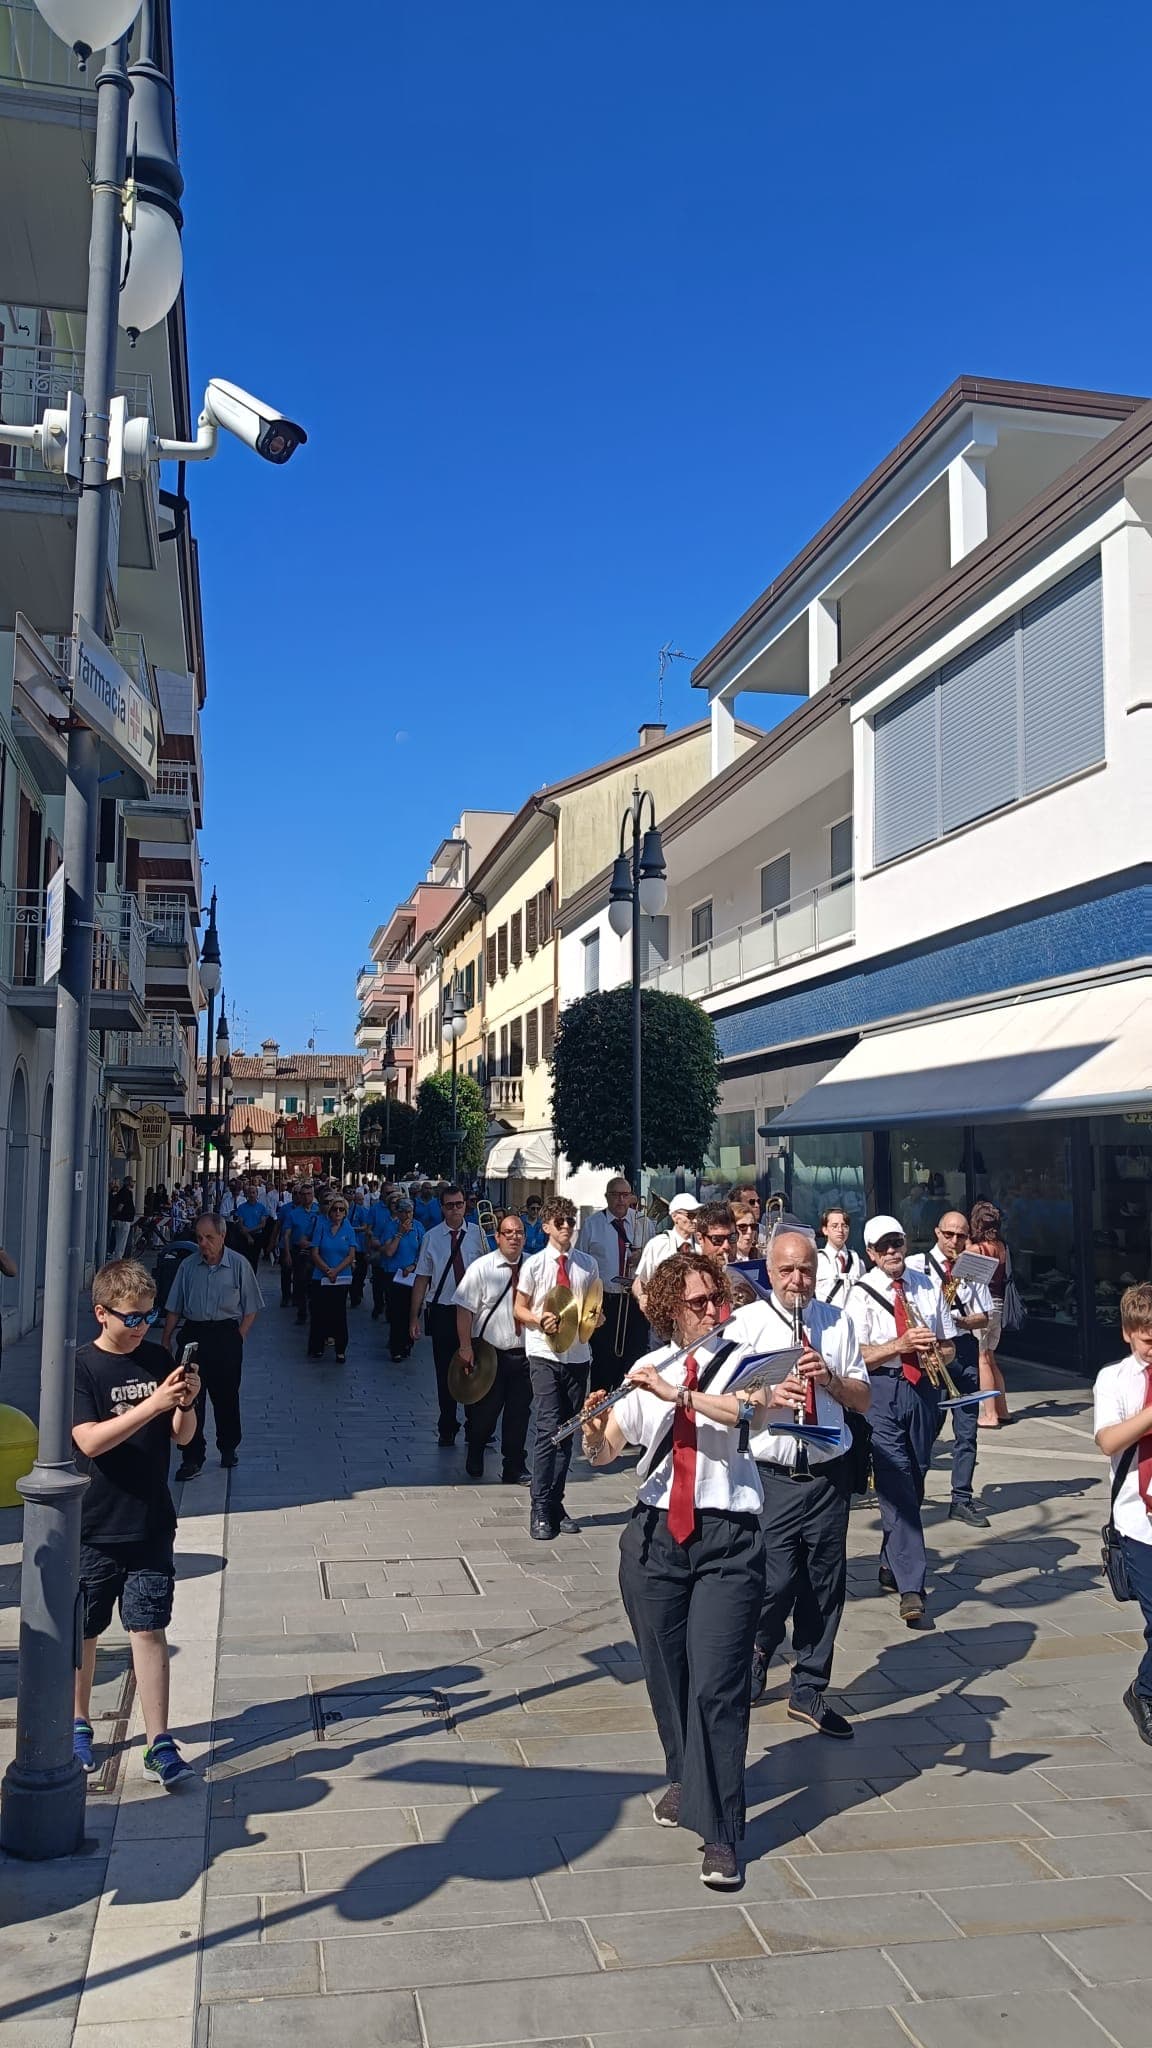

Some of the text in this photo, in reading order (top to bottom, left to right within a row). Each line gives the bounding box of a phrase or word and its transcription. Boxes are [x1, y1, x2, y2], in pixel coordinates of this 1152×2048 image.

[78, 641, 126, 725] farmacia
[141, 1115, 167, 1124] ANIFICIO
[111, 1381, 158, 1402] arena
